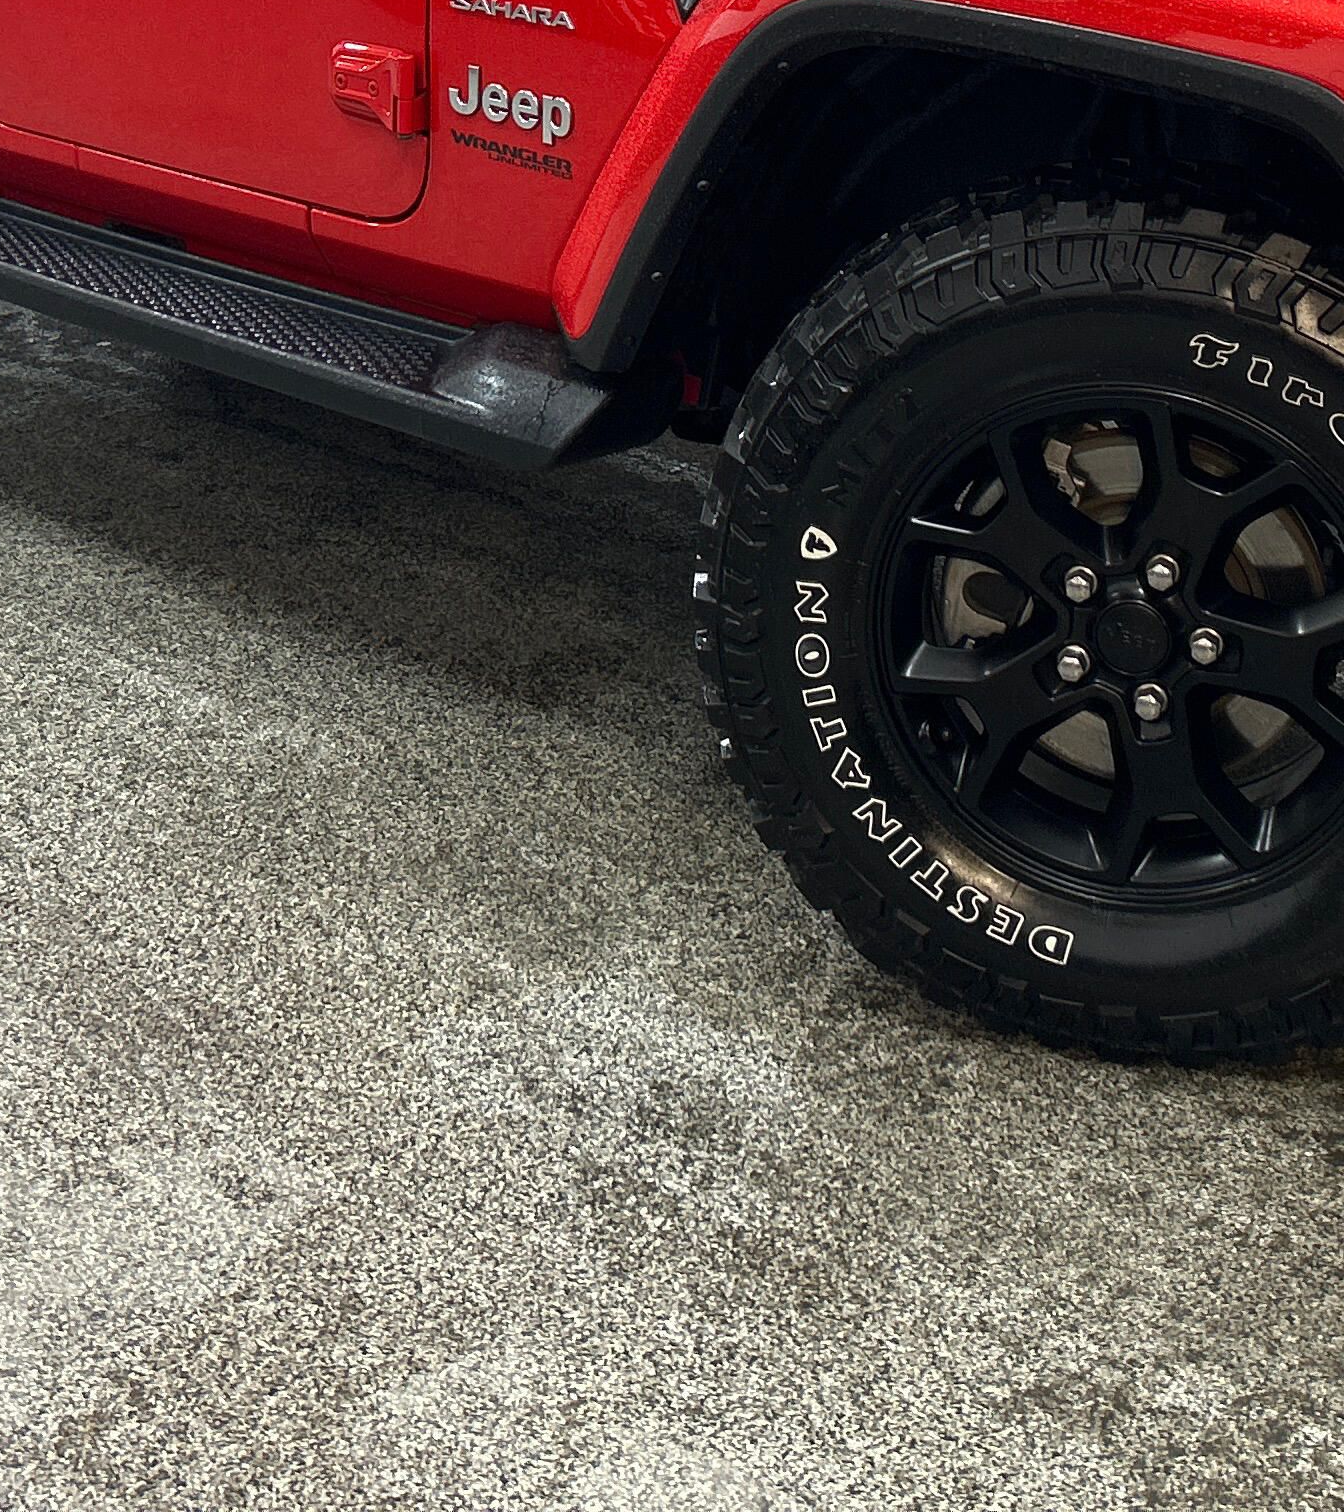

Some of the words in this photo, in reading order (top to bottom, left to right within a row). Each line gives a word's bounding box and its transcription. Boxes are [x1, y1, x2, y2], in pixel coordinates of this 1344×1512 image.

[448, 63, 573, 146] Jeep
[451, 128, 573, 173] WRANGLER
[488, 152, 573, 180] UNLIMITED
[794, 581, 1074, 966] DESTINATION
